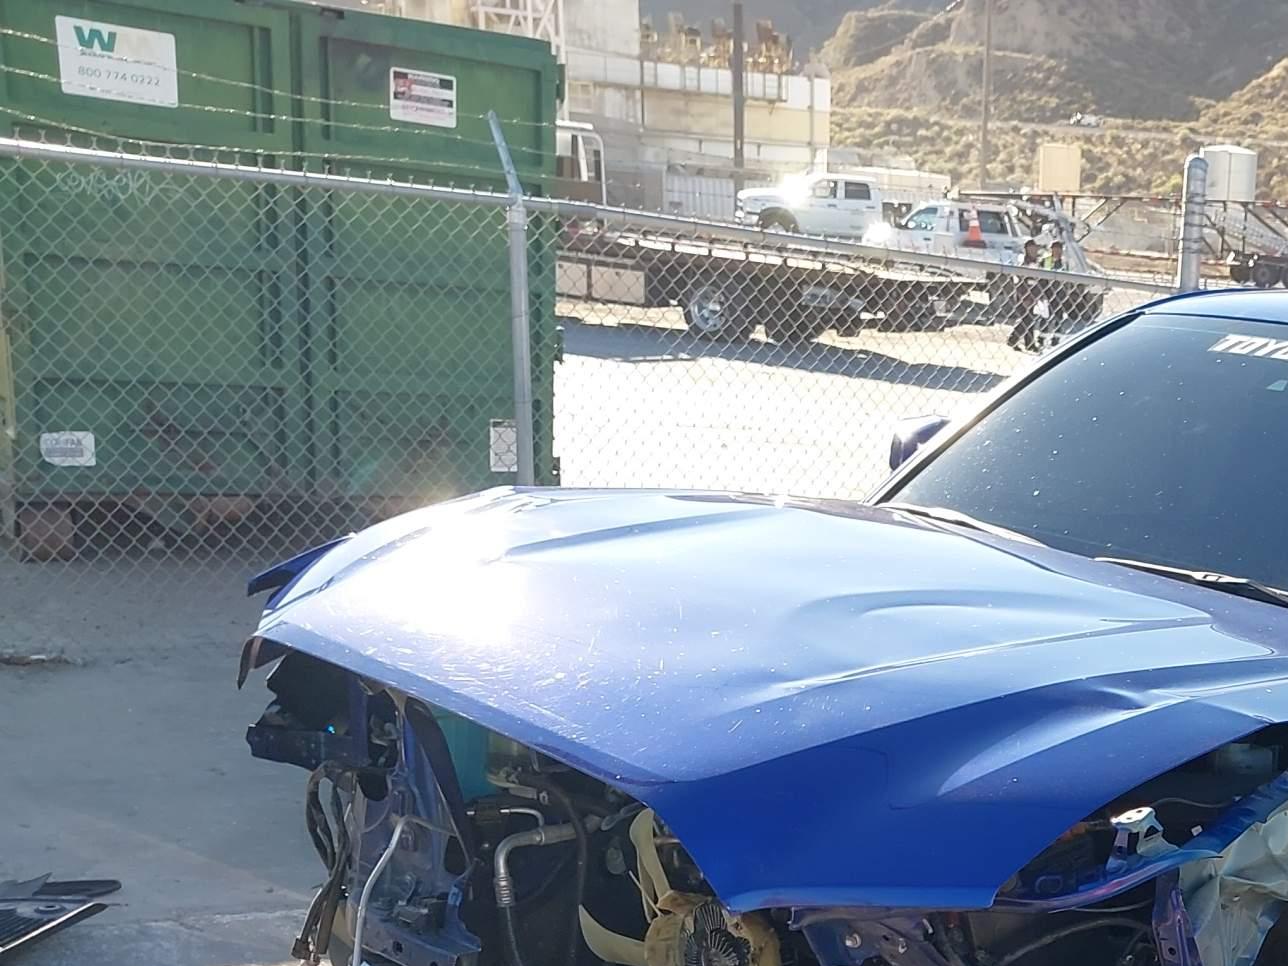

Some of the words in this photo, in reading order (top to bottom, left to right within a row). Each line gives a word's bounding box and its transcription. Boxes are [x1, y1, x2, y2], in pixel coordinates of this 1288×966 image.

[78, 65, 101, 78] 800
[105, 70, 128, 81] 774
[130, 74, 161, 88] 0222
